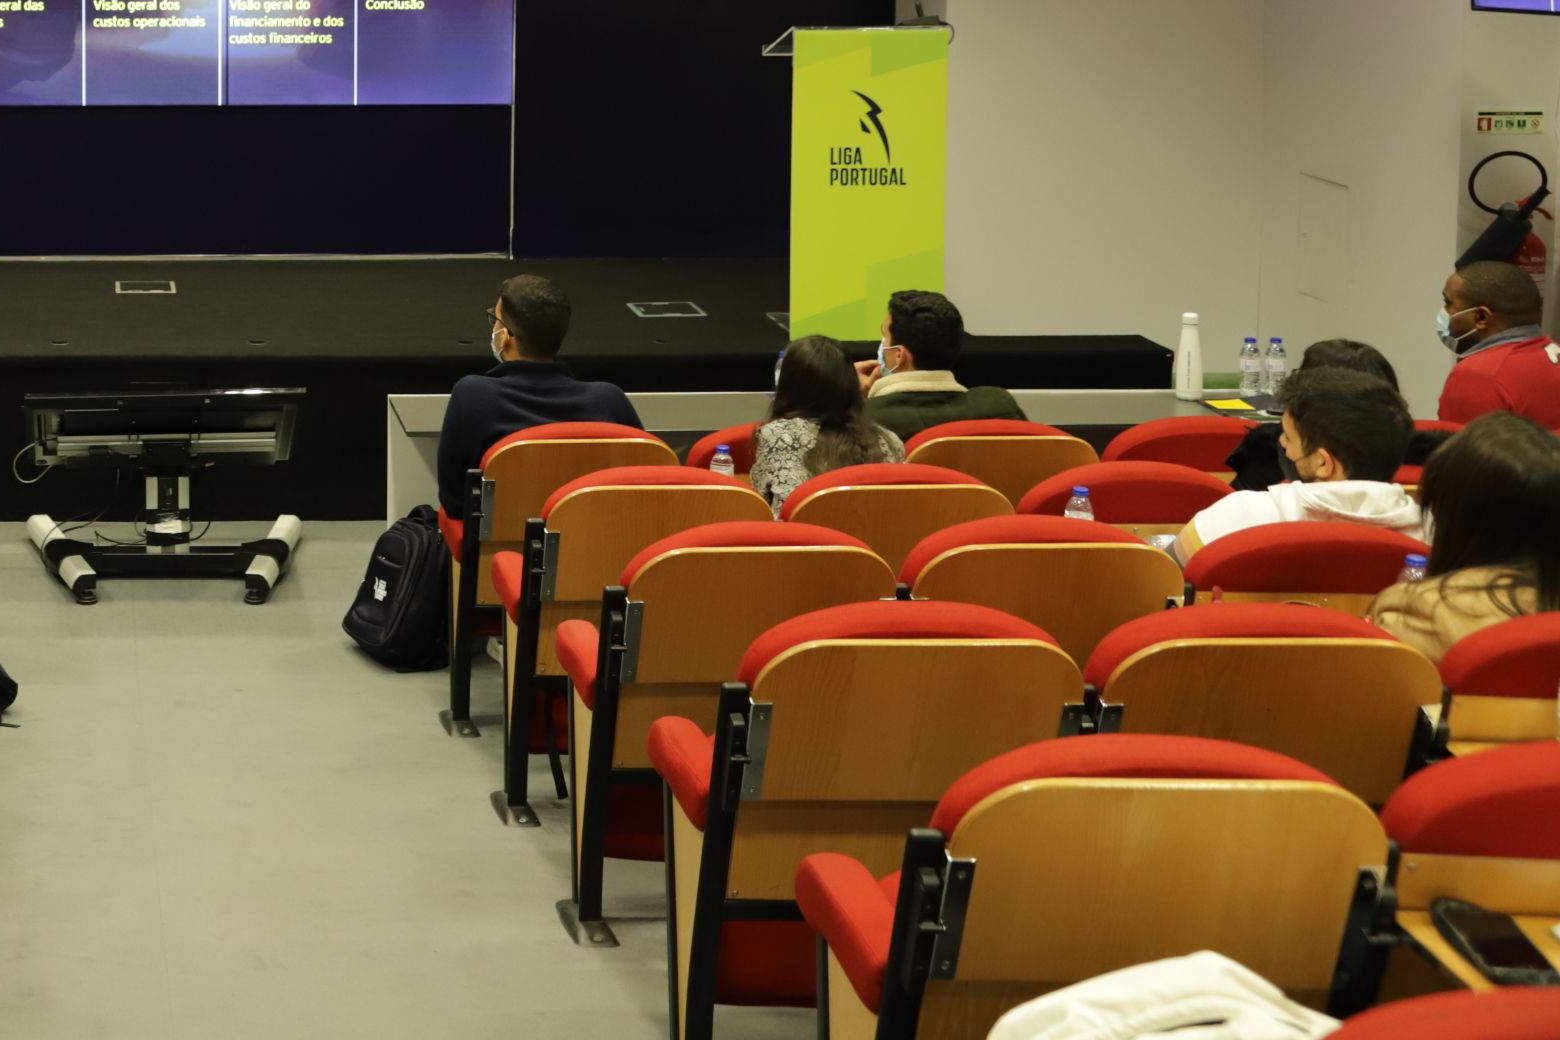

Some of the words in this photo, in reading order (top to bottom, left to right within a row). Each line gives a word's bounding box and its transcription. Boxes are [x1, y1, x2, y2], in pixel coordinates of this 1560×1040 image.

[23, 0, 44, 11] das
[93, 0, 125, 11] Visão
[127, 0, 157, 14] geral
[159, 0, 180, 11] dos
[229, 0, 261, 11] Visão
[263, 0, 292, 13] geral
[294, 0, 310, 11] do
[93, 16, 130, 28] custos
[133, 15, 206, 30] operacionais
[229, 15, 311, 28] financiamento
[313, 18, 321, 28] e
[323, 15, 344, 28] dos
[229, 32, 266, 44] custos
[269, 31, 332, 44] financeiros
[830, 147, 863, 165] LIGA
[829, 167, 907, 186] PORTUGAL
